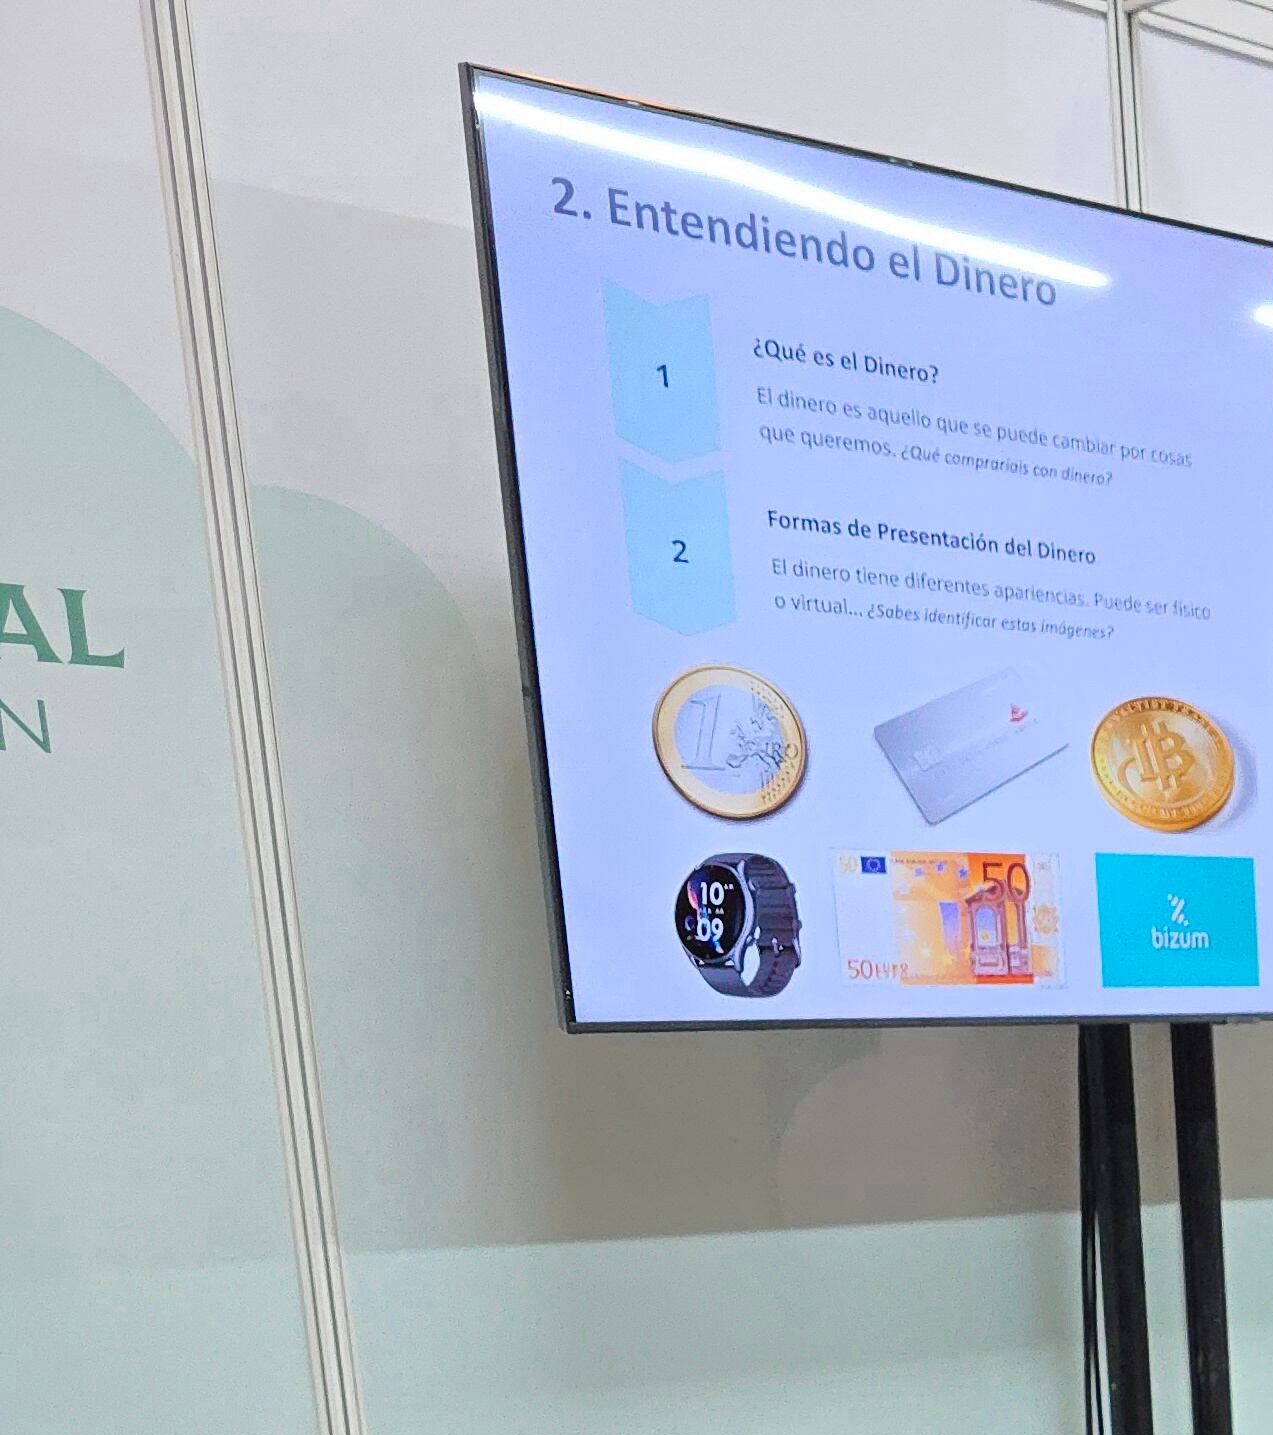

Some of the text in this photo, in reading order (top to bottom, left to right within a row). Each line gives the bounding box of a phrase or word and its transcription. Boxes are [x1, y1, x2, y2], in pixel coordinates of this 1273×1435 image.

[552, 177, 1056, 305] 2. Entendiendo el Dinero
[656, 364, 669, 388] 1
[753, 338, 939, 384] ¿Qué es el Dinero?
[757, 387, 1193, 468] El dinero es aquello que se puede cambiar por cosas
[759, 424, 795, 444] que
[800, 429, 897, 457] queremos.
[901, 445, 940, 465] ¿Qué
[1033, 465, 1058, 479] con
[1061, 467, 1113, 487] dinero?
[671, 539, 690, 564] 2
[767, 510, 1096, 564] Formas de Presentación del Dinero
[771, 557, 787, 576] El
[792, 560, 851, 583] dinero
[856, 566, 900, 588] tiene
[905, 571, 990, 597] diferentes
[994, 583, 1090, 607] apariencias.
[1094, 591, 1142, 613] Puede
[1146, 600, 1169, 615] ser
[774, 594, 1115, 640] o virtual... ¿Sabes identificar estas imágenes?
[700, 881, 725, 906] 10
[982, 861, 1030, 901] 50
[696, 917, 724, 942] 09
[1151, 925, 1209, 949] bizum
